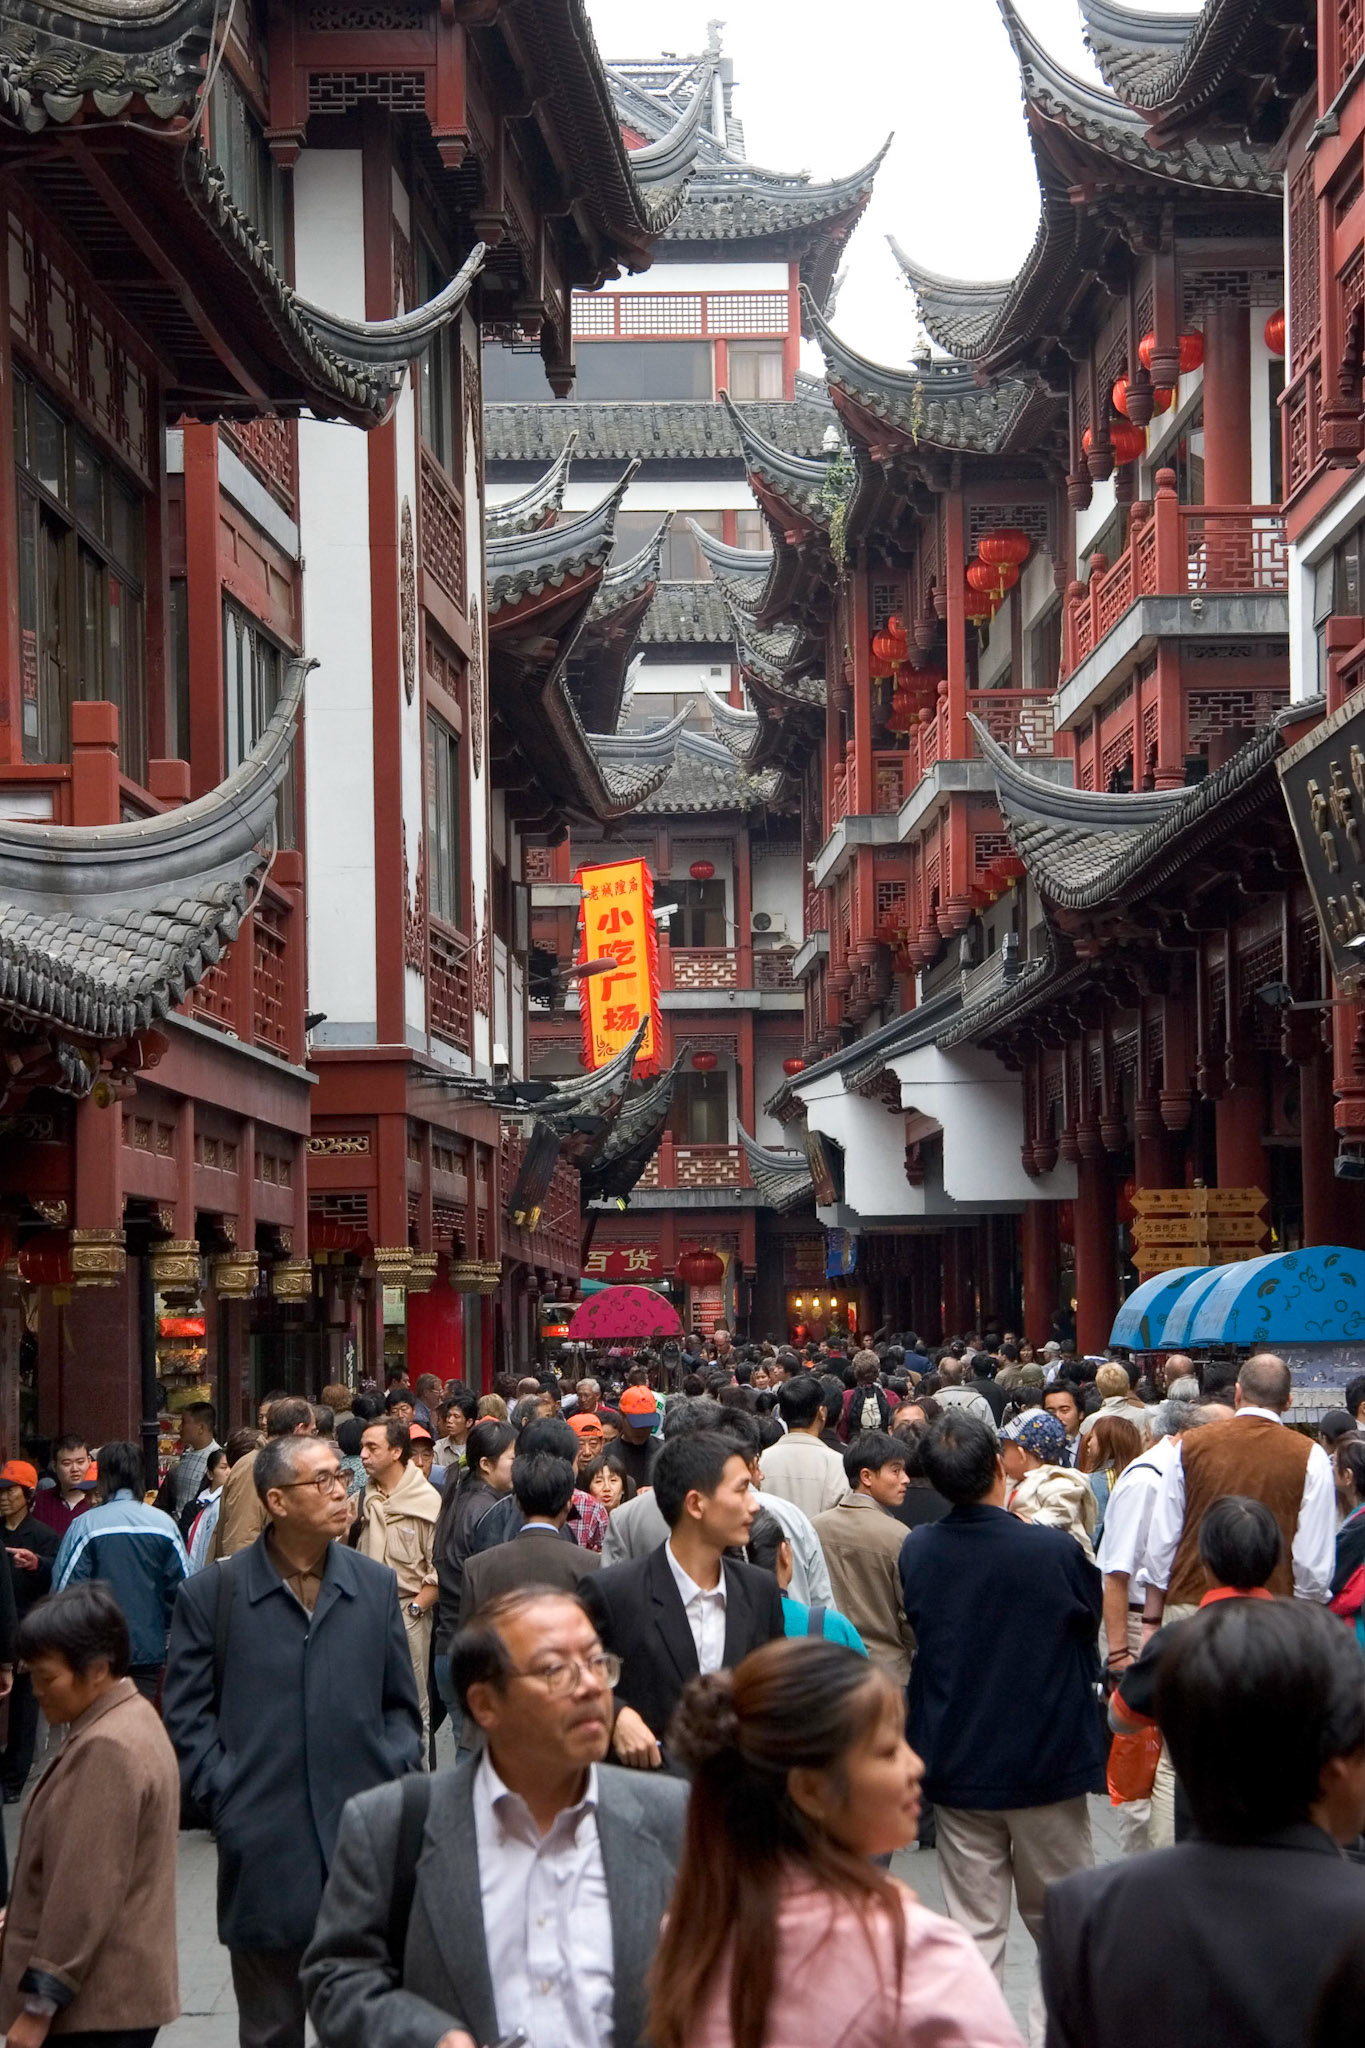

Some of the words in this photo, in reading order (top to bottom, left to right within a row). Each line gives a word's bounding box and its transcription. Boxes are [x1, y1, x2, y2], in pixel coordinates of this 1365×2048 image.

[588, 876, 638, 901] 老城隍庙
[597, 907, 640, 1032] 小吃广场
[584, 1248, 658, 1273] 百货
